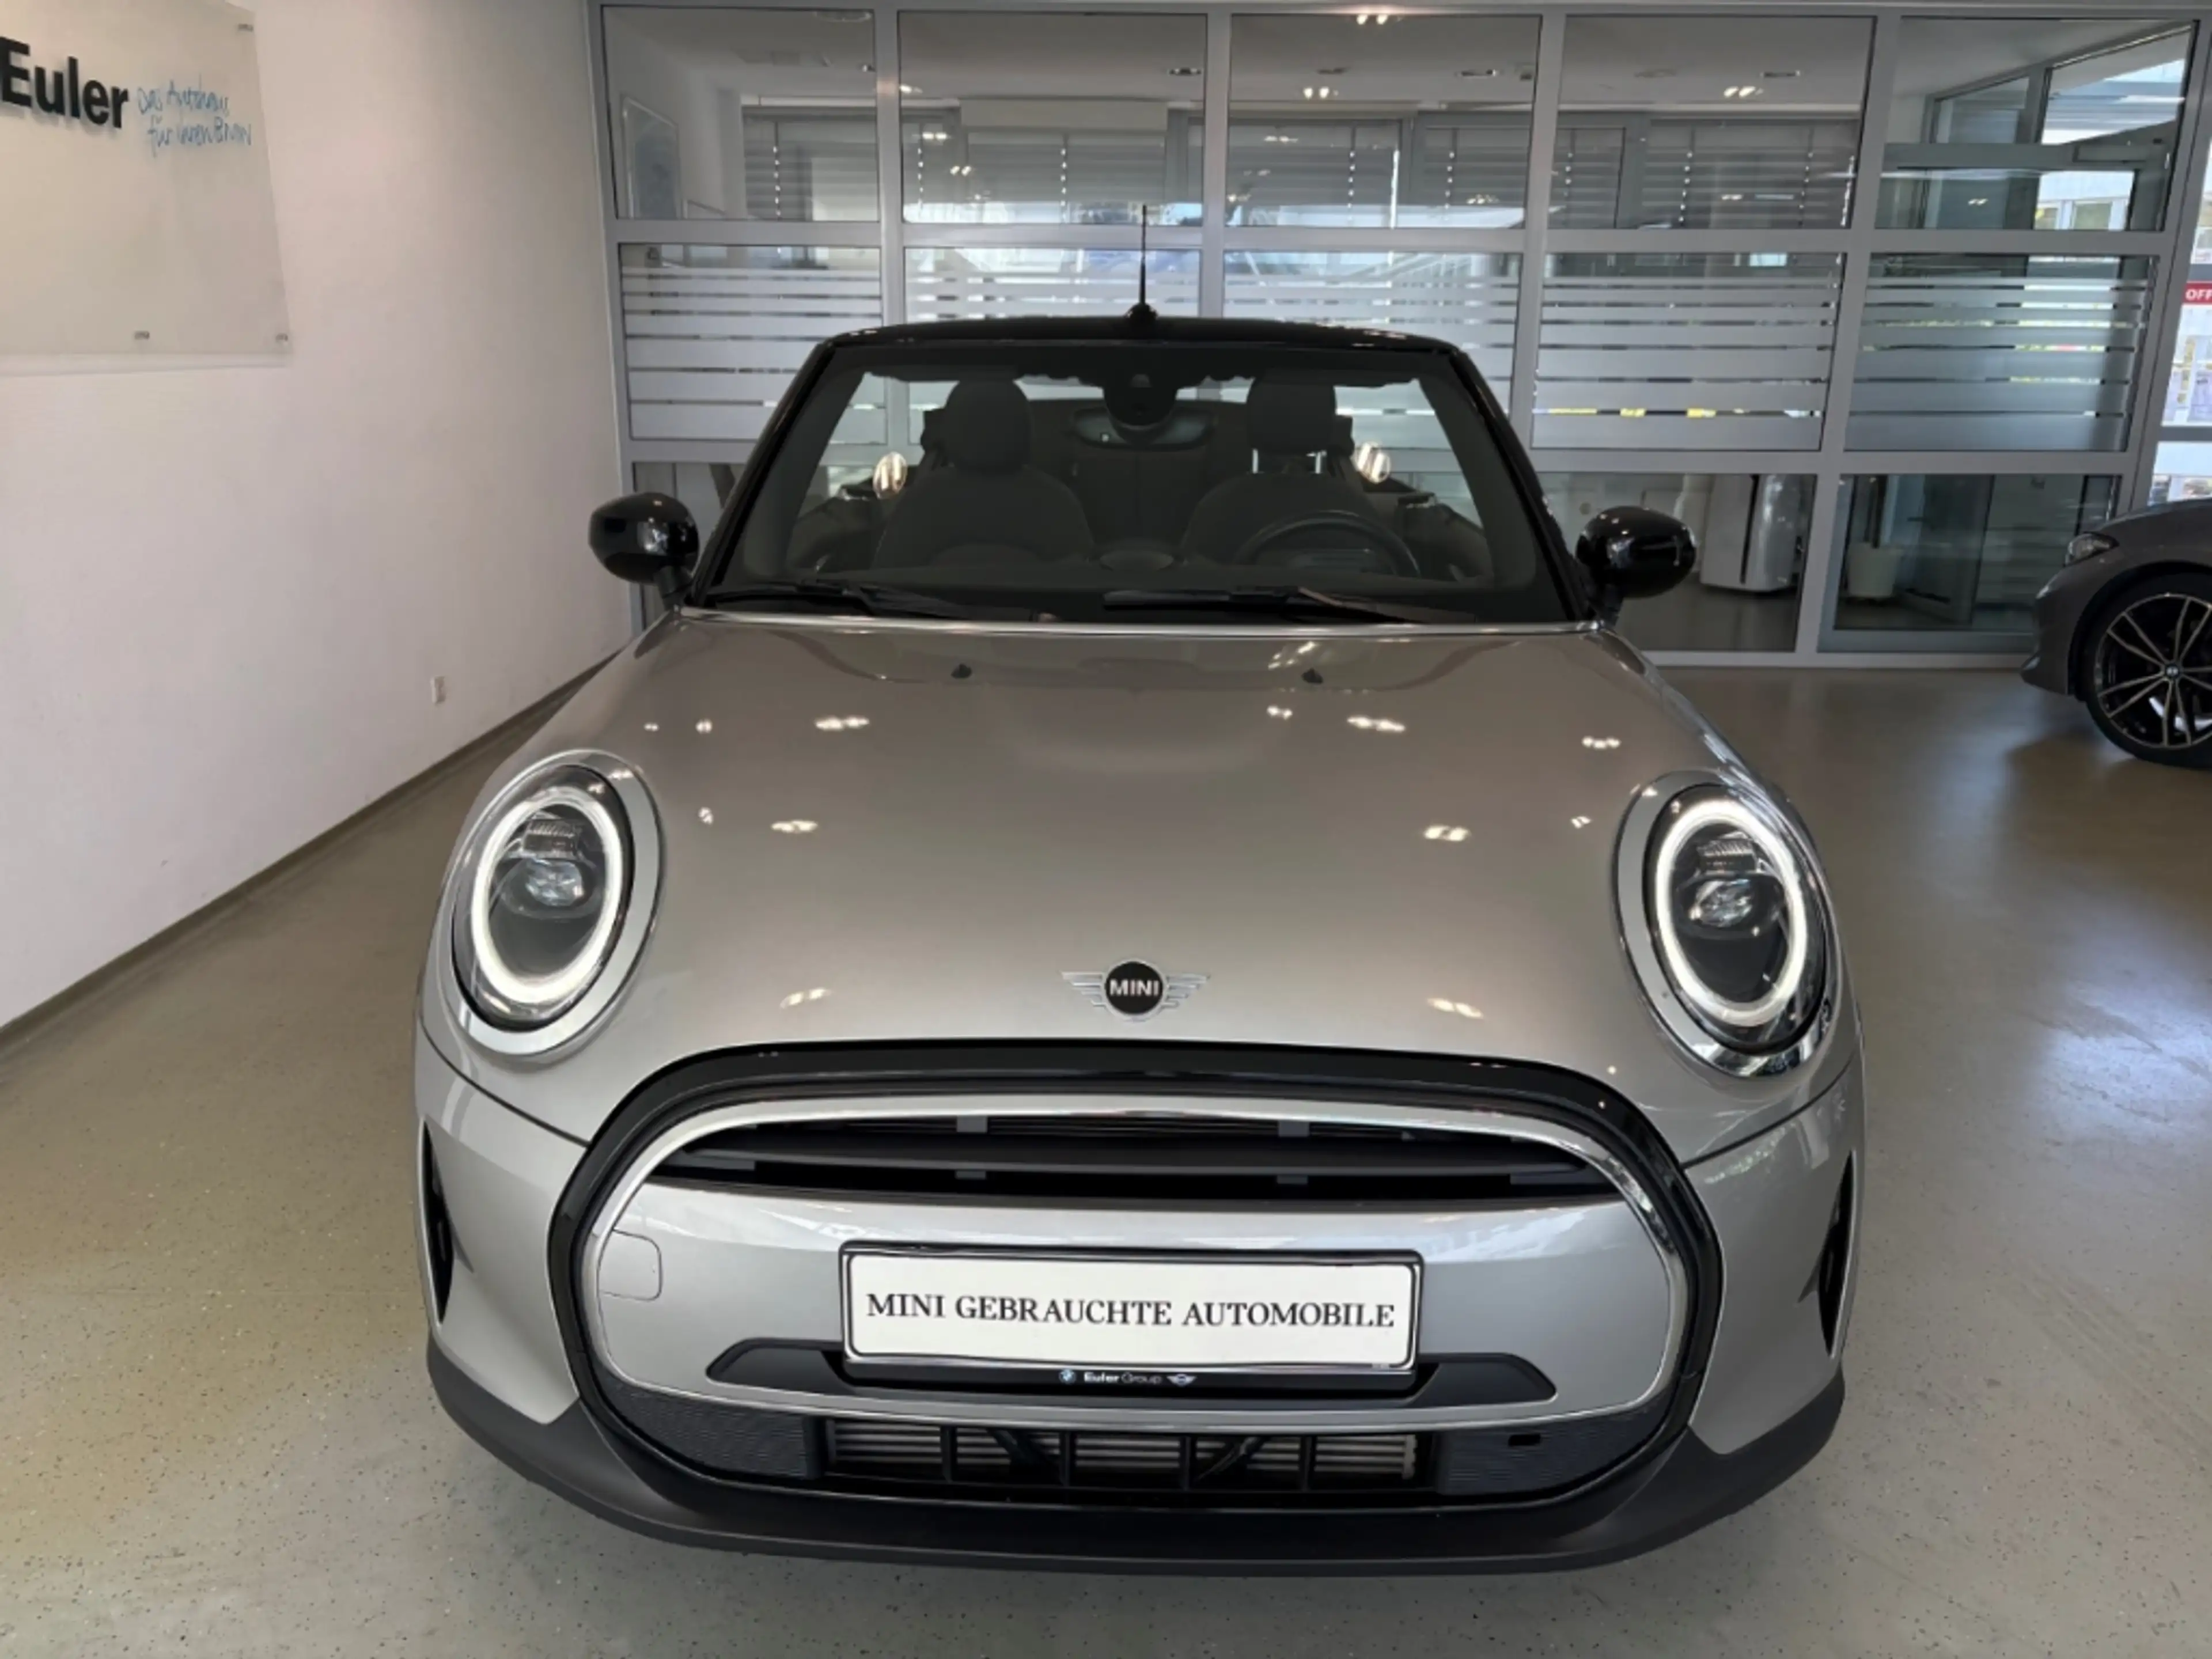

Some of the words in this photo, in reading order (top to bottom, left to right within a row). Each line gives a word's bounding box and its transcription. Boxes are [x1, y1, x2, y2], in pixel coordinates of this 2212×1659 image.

[0, 36, 128, 128] Euler
[1109, 979, 1160, 997] MINI
[866, 1293, 946, 1318] MINI
[955, 1295, 1172, 1325] GEBRAUCHTE
[1181, 1301, 1395, 1328] AUTOMOBILE
[1084, 1371, 1119, 1383] Euler
[1121, 1372, 1163, 1385] Group
